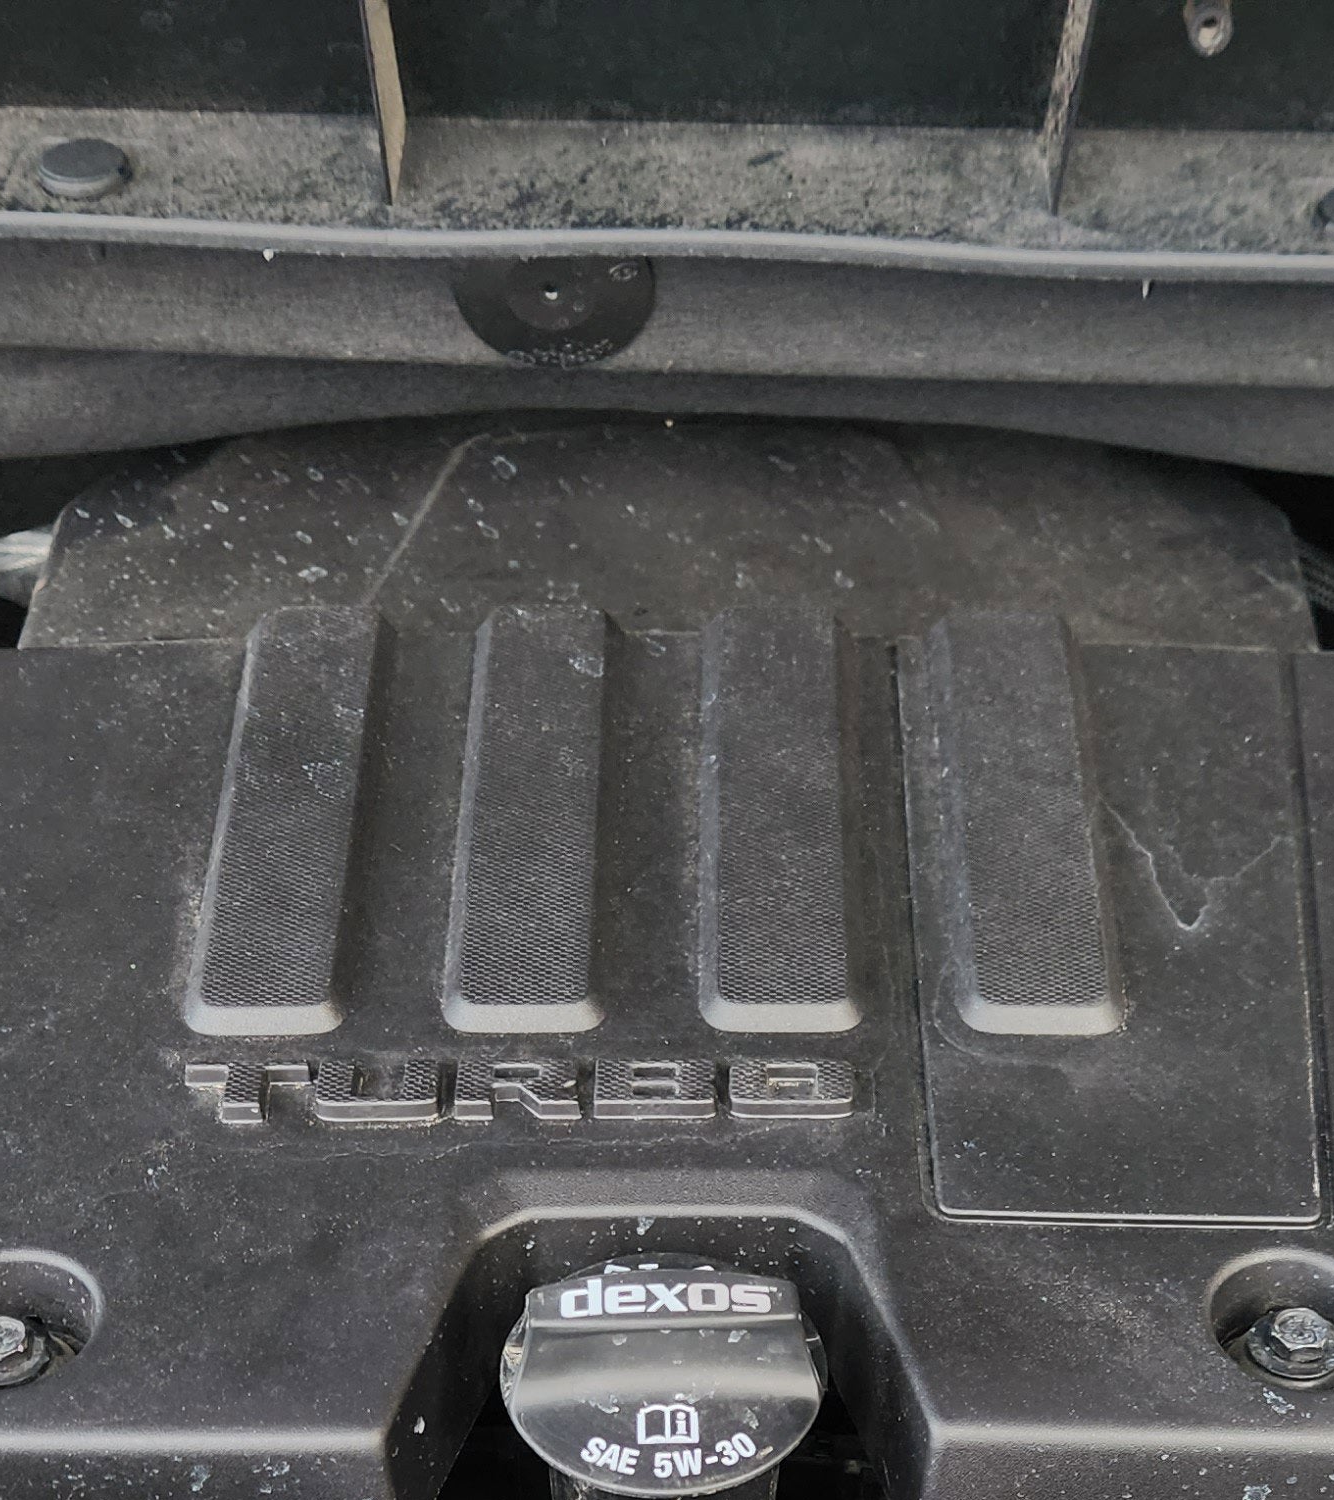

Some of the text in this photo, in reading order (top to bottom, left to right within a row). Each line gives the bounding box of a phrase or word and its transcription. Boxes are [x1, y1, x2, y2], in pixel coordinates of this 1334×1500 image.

[184, 1058, 859, 1123] TURBO
[560, 1278, 772, 1318] dexos
[580, 1432, 757, 1479] SAE 5W-30
